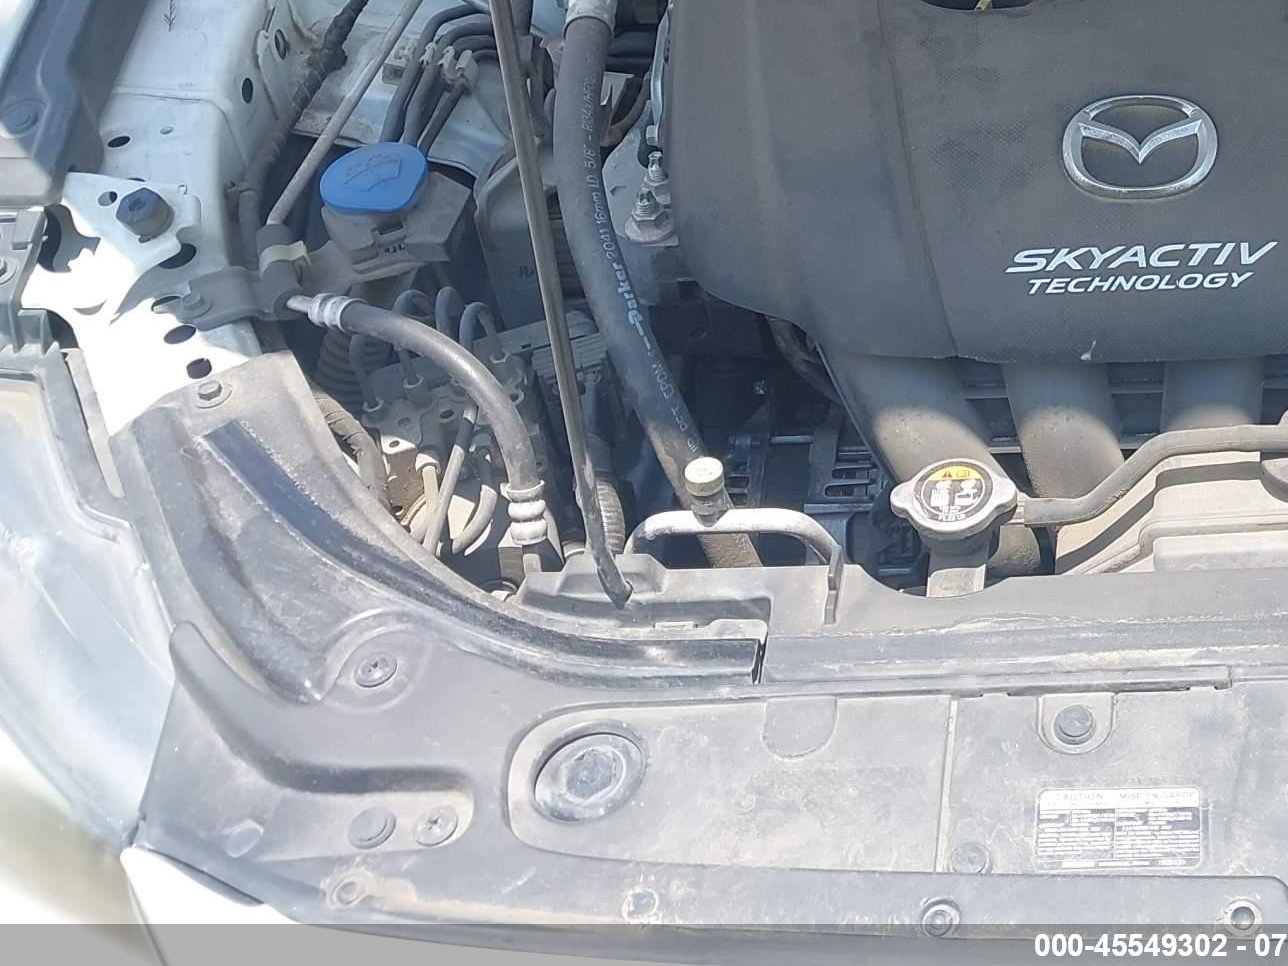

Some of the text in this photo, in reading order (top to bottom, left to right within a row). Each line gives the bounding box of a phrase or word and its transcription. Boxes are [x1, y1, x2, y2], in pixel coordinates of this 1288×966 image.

[1005, 241, 1278, 273] SKYACTIV
[611, 261, 644, 325] Parker
[1028, 272, 1255, 295] TECHNOLOGY
